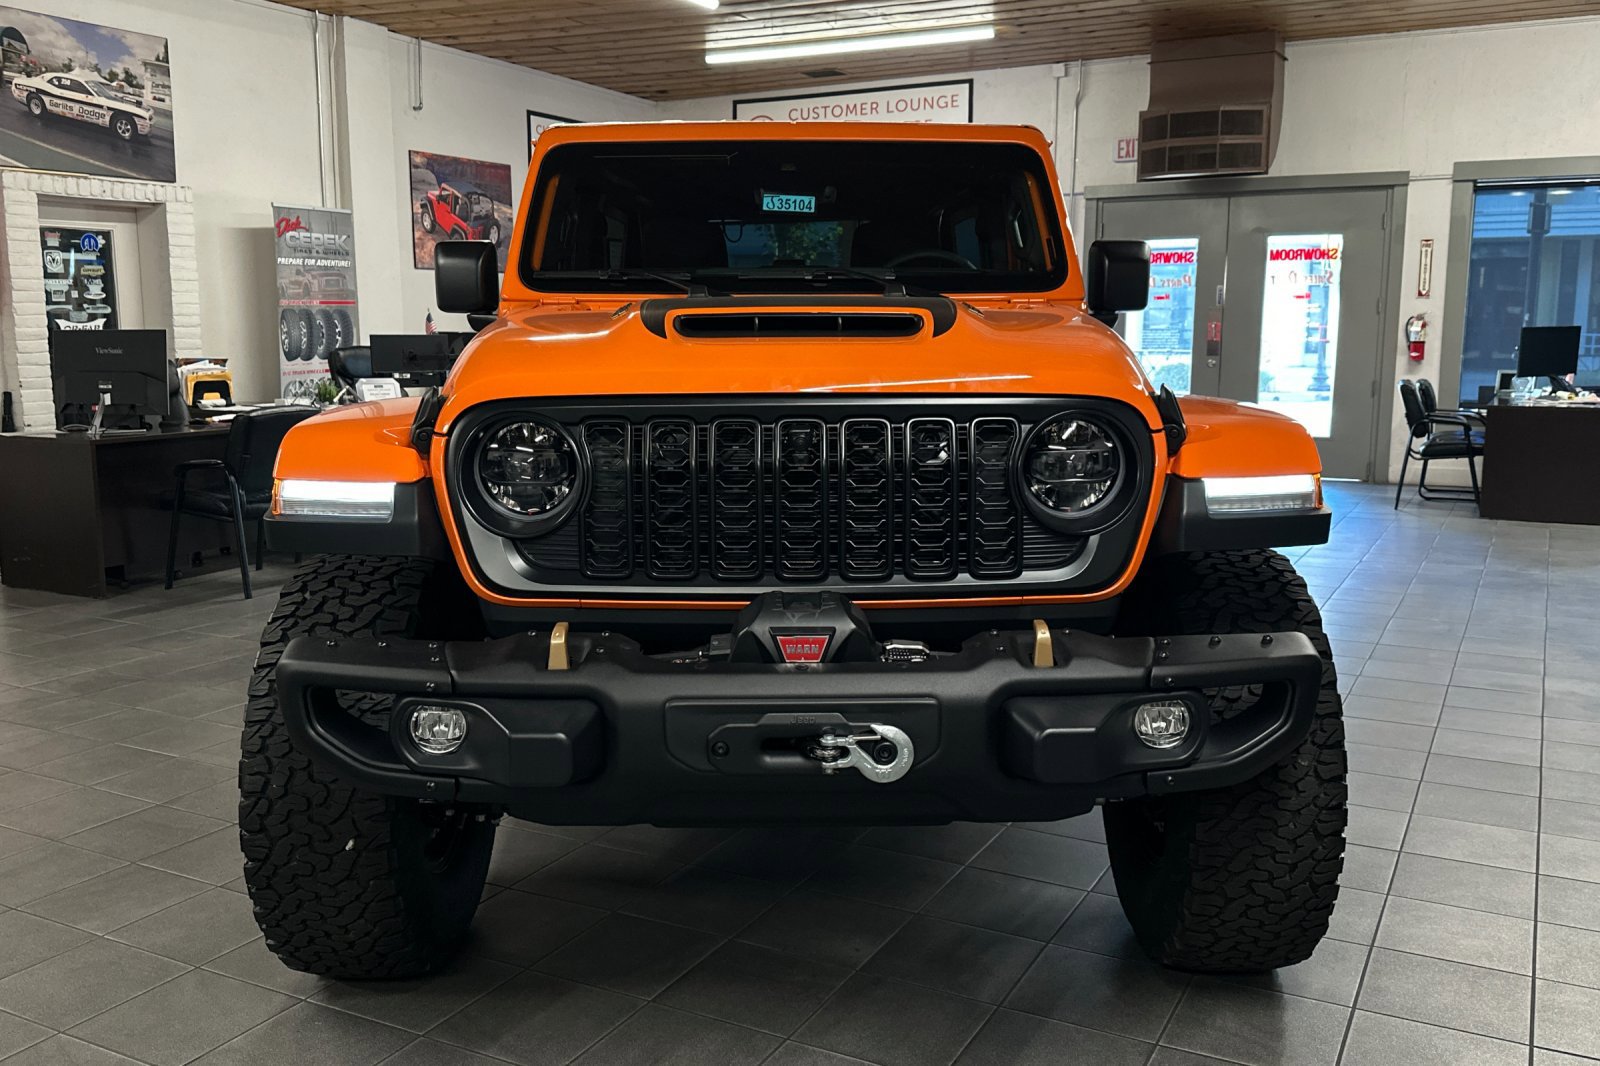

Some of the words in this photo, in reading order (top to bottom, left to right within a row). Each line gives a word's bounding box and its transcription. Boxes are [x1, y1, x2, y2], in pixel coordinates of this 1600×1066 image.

[49, 99, 74, 112] Garlits
[78, 106, 106, 120] Dodge
[788, 101, 880, 122] CUSTOMER
[886, 94, 960, 114] LOUNGE
[1117, 138, 1138, 159] EXI
[285, 231, 351, 249] CEPEK
[277, 257, 303, 266] PREPARE
[304, 258, 315, 266] FOR
[316, 259, 351, 268] ADVENTURE!
[95, 346, 123, 355] ViewSonic
[786, 644, 819, 654] WARN
